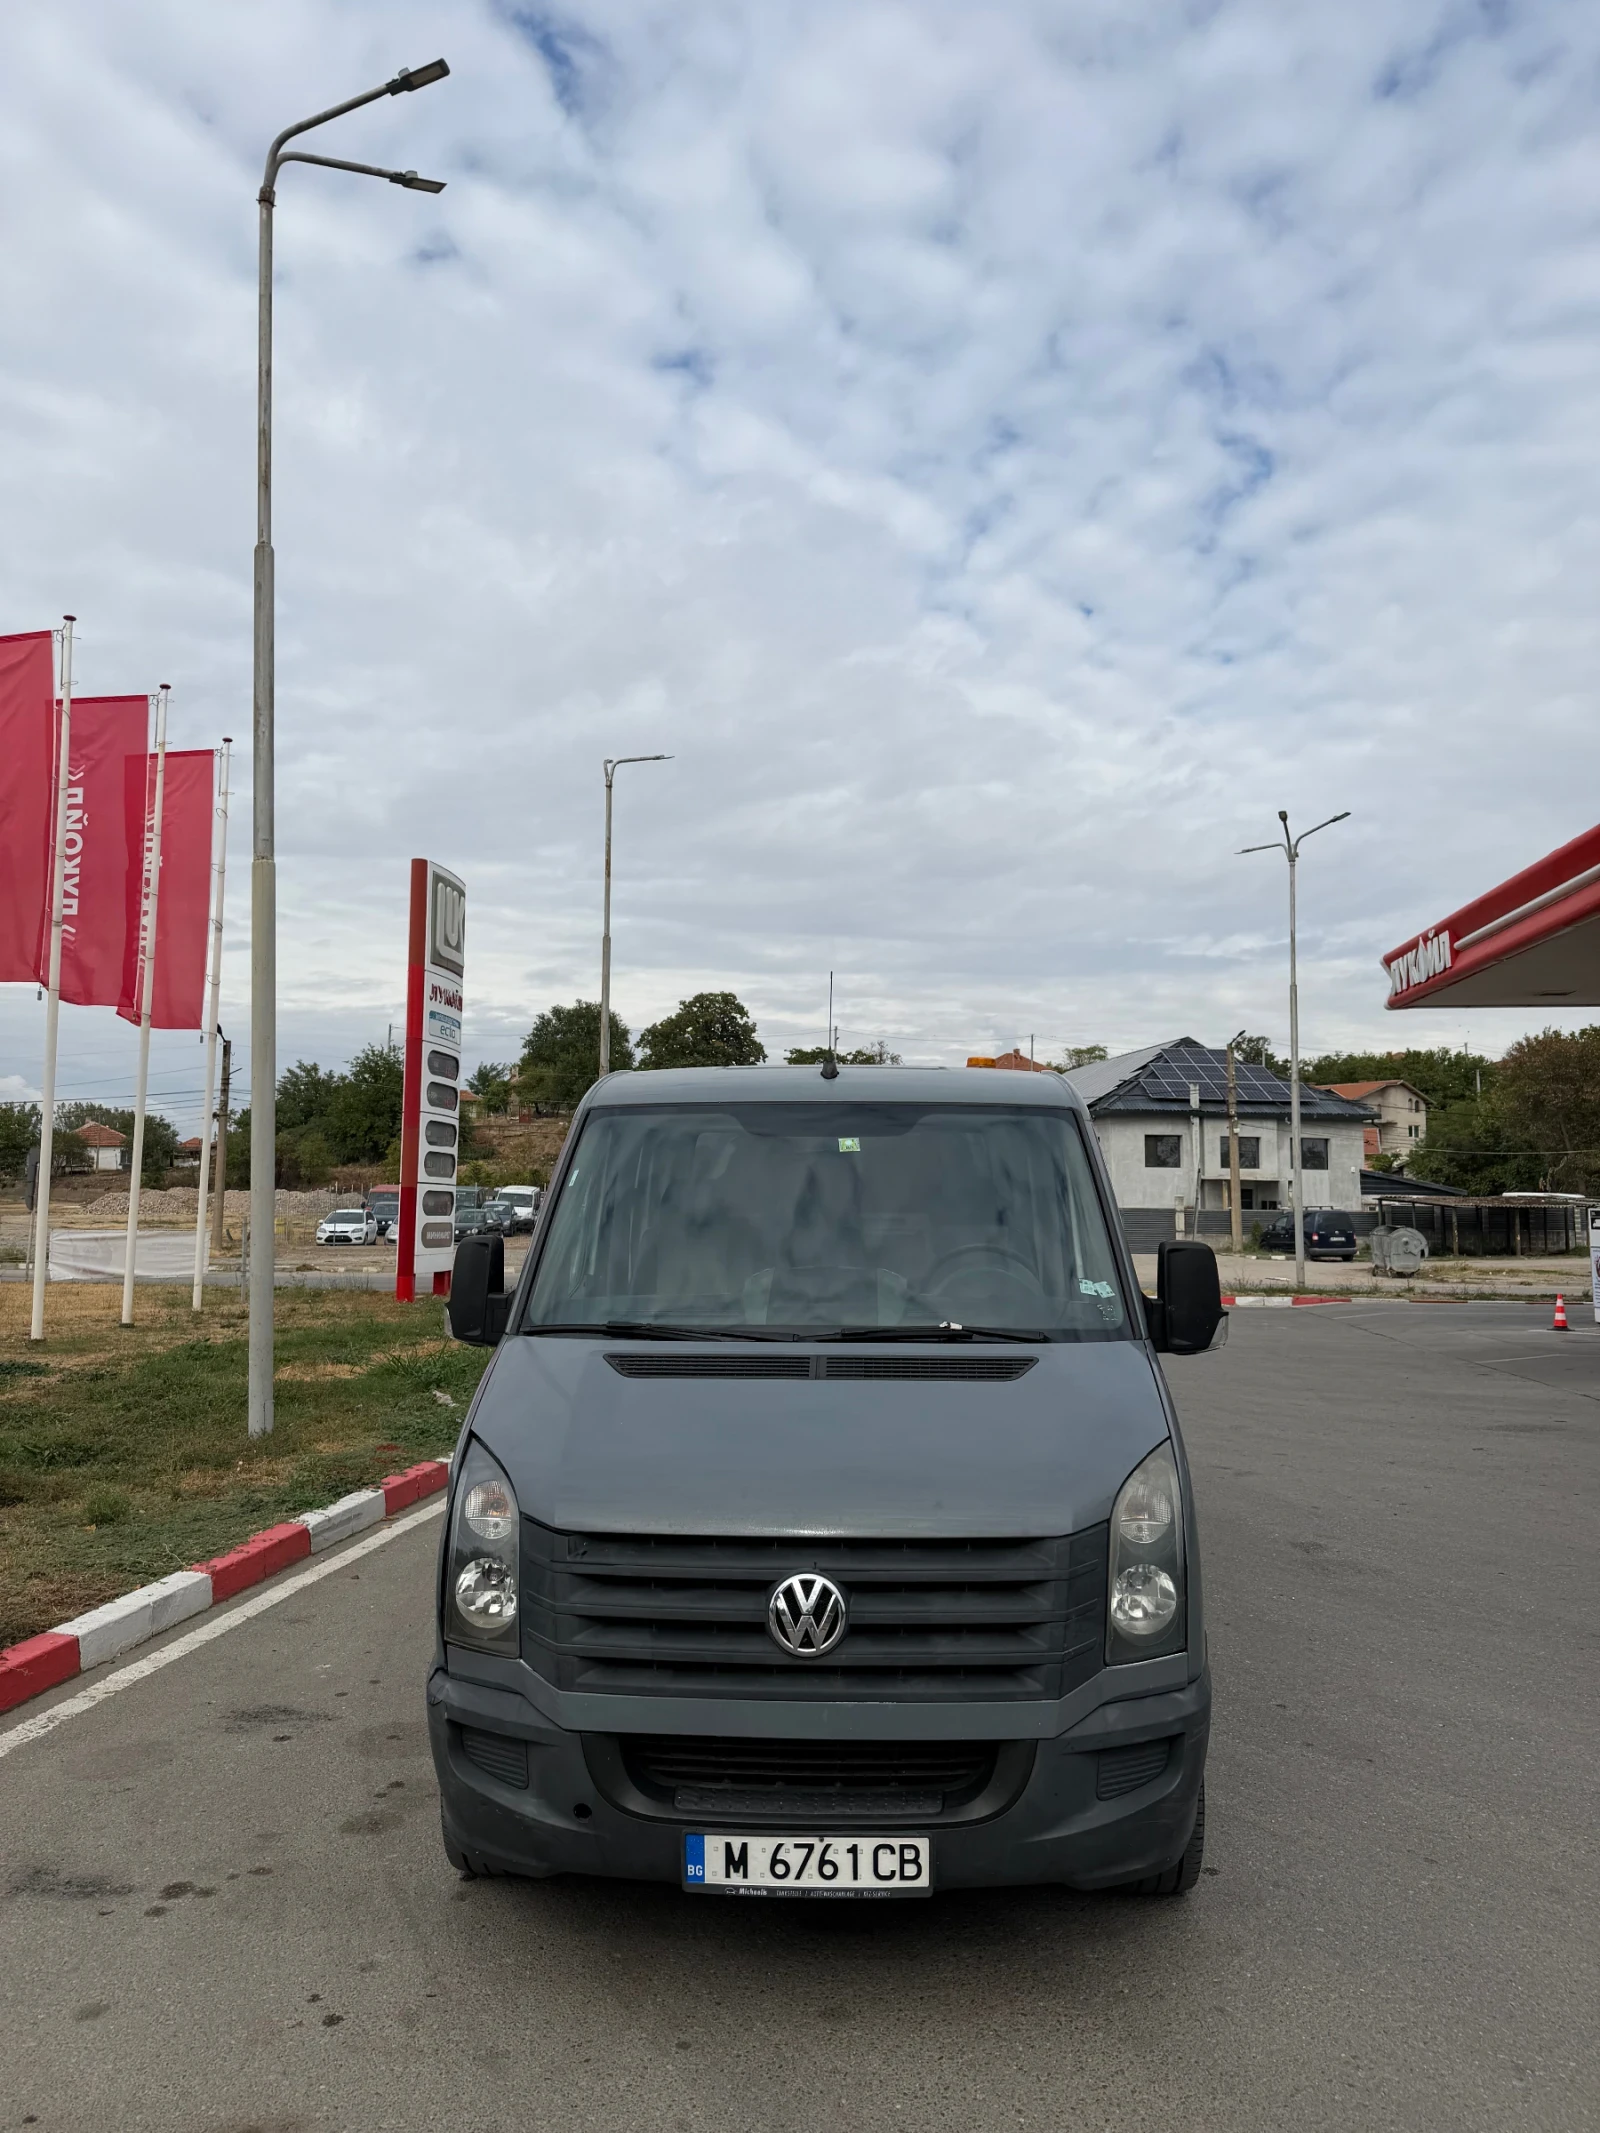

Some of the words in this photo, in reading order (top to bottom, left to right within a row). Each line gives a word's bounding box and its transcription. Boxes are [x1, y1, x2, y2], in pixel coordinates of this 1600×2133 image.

[1390, 929, 1452, 996] ЛУКОЙЛ
[440, 1025, 455, 1039] ecto
[687, 1864, 703, 1876] BG
[724, 1841, 749, 1879] M
[769, 1843, 859, 1881] 6761
[872, 1843, 923, 1881] CB
